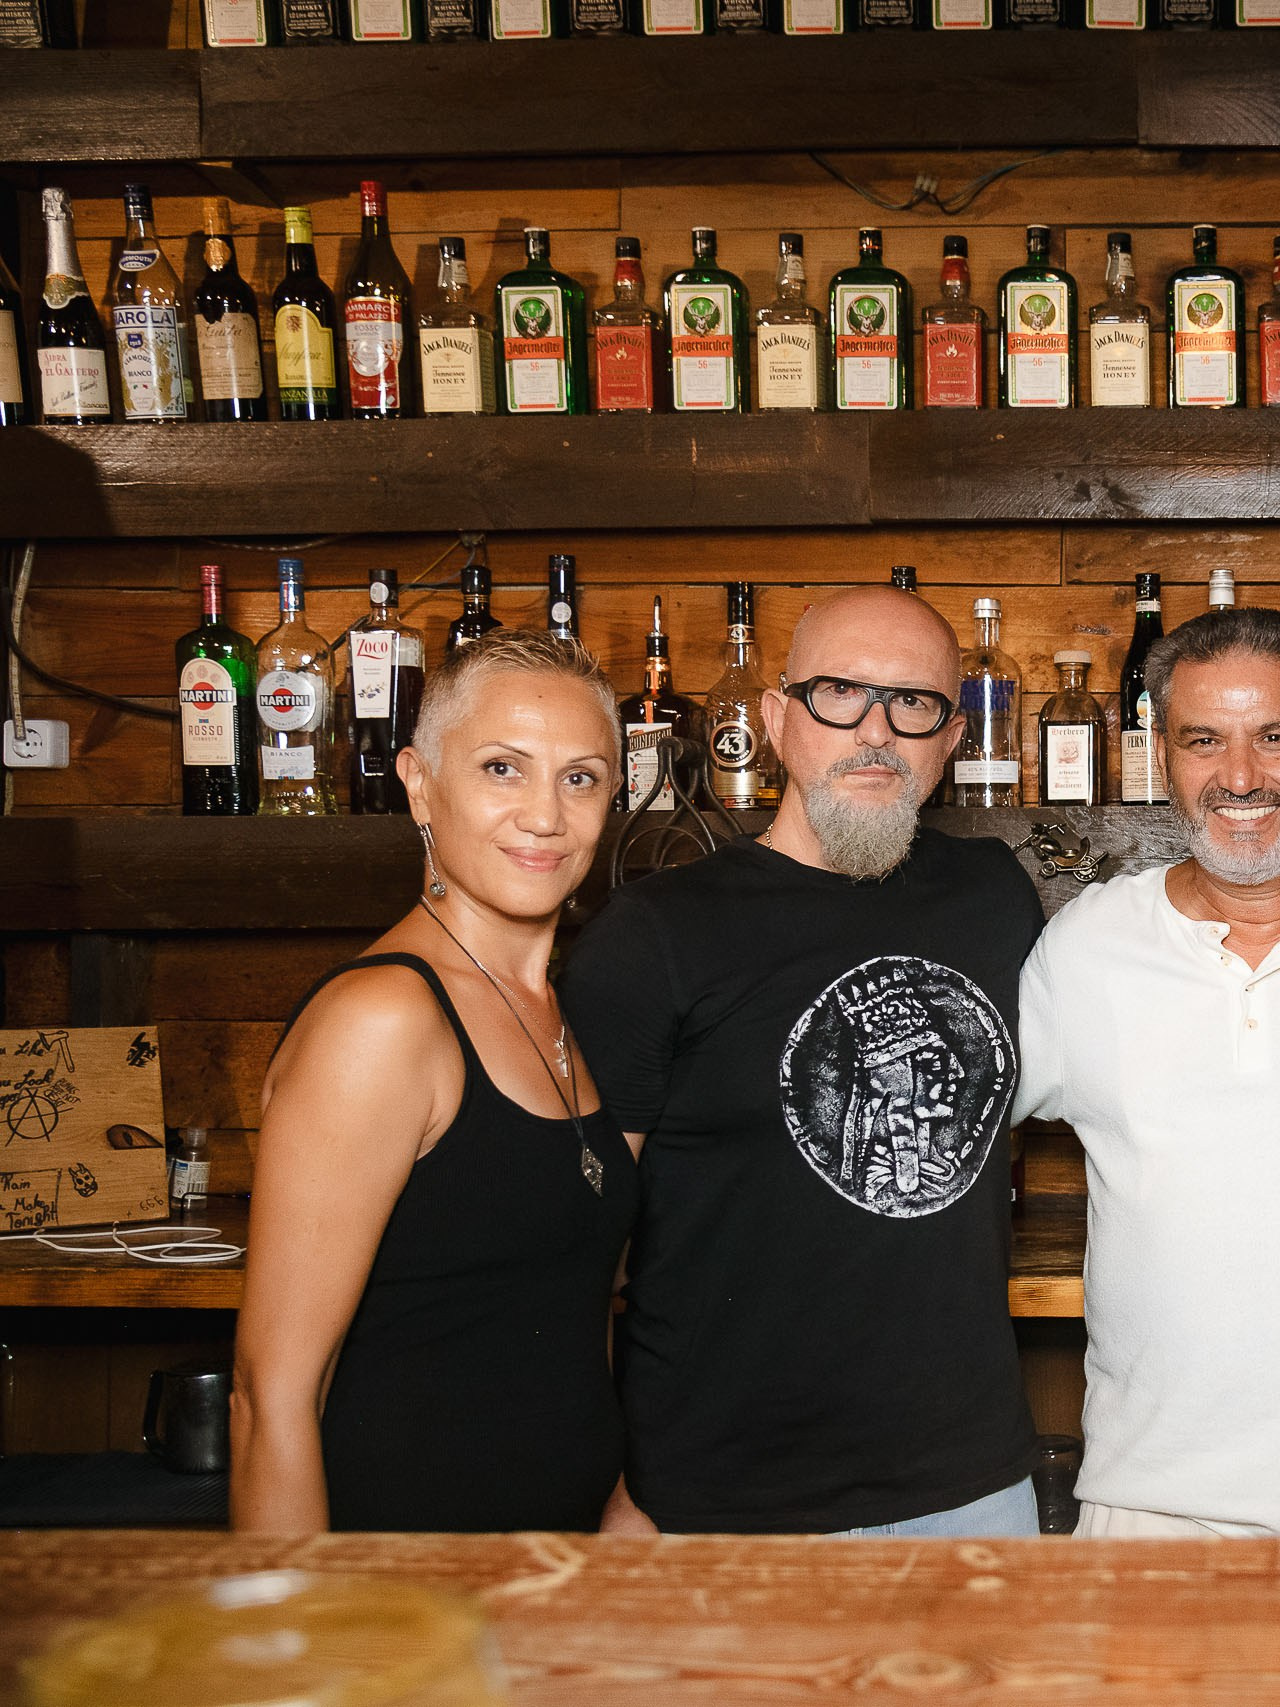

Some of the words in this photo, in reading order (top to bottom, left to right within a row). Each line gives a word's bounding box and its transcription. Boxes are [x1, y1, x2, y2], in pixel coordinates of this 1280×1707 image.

[1094, 335, 1114, 351] JACK
[181, 690, 233, 703] MARTINI
[260, 695, 309, 706] MARTINI
[188, 725, 223, 736] ROSSO
[716, 732, 747, 755] 43
[1127, 735, 1152, 748] FERN
